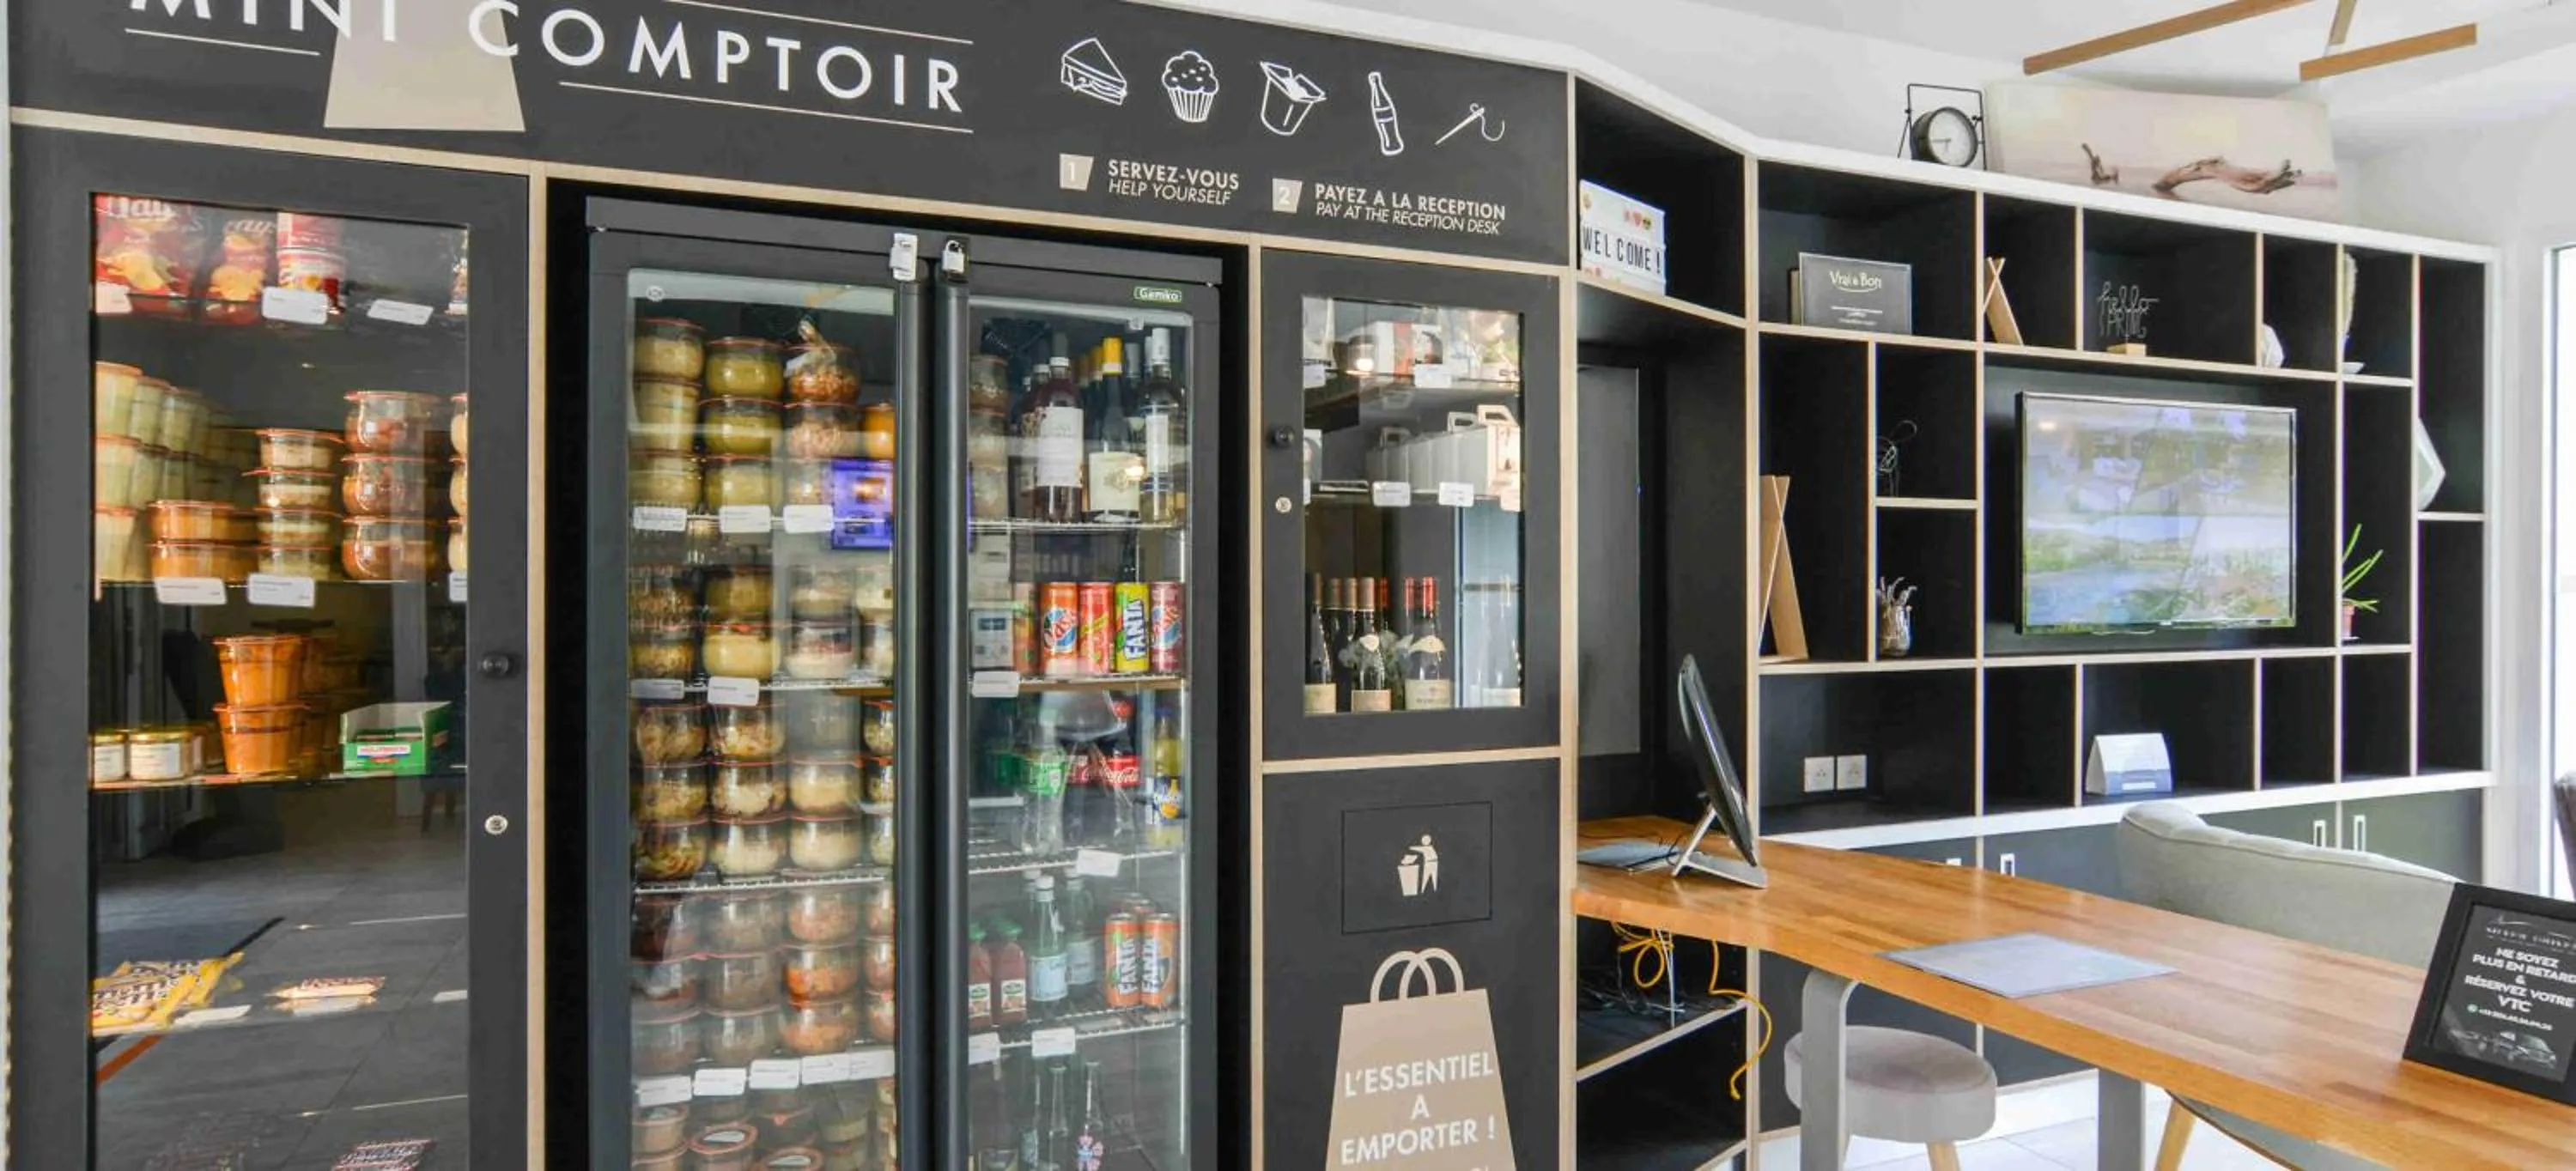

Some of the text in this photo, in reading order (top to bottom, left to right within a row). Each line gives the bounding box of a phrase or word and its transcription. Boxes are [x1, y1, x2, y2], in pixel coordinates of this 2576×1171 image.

[469, 0, 962, 112] COMPTOIR
[1067, 161, 1075, 182] 1
[1108, 159, 1240, 191] SERVEZ-VOUS
[1109, 179, 1232, 207] HELP YOURSELF
[1278, 185, 1291, 206] 2
[1314, 182, 1507, 221] PAYEZ A LA RECEPTION
[1315, 201, 1503, 236] PAY AT THE RECEPTION DESK
[2472, 954, 2576, 985] PLUS EN RETARD
[2495, 947, 2560, 969] NE SOYEZ
[2464, 974, 2575, 1009] RÉSERVEZ VOTRE
[2497, 994, 2534, 1013] VTC
[1345, 1051, 1494, 1098] L'ESSENTIEL
[1409, 1093, 1431, 1120] A
[1340, 1118, 1479, 1166] EMPORTER
